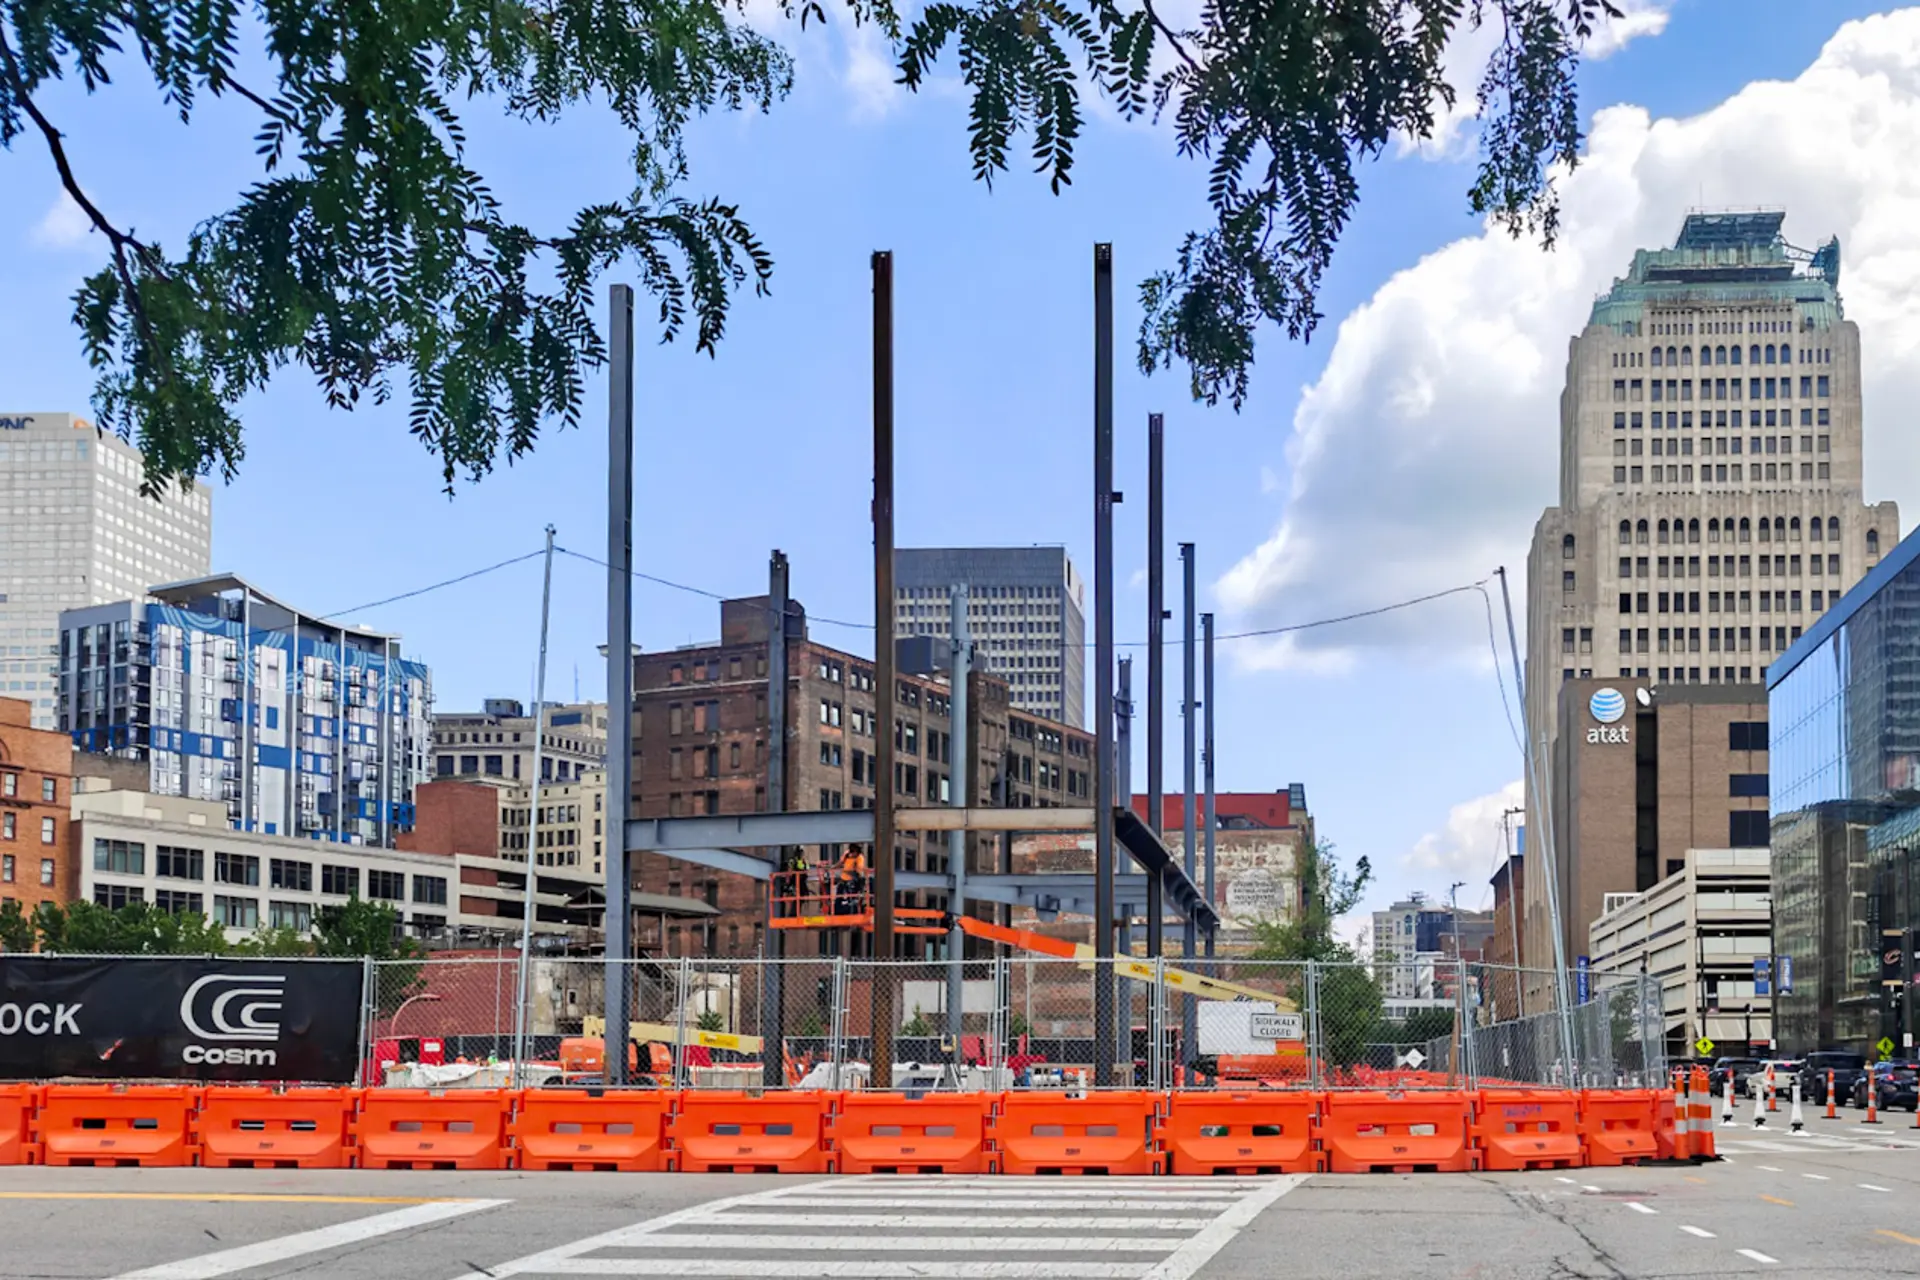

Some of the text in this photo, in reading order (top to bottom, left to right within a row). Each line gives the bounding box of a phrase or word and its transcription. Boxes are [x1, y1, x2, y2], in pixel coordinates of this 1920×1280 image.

[1586, 724, 1630, 744] at&t
[0, 1002, 83, 1035] OCK
[1255, 1017, 1297, 1026] SIDEWALK
[1260, 1027, 1292, 1037] CLOSED
[182, 1044, 277, 1066] Cosm
